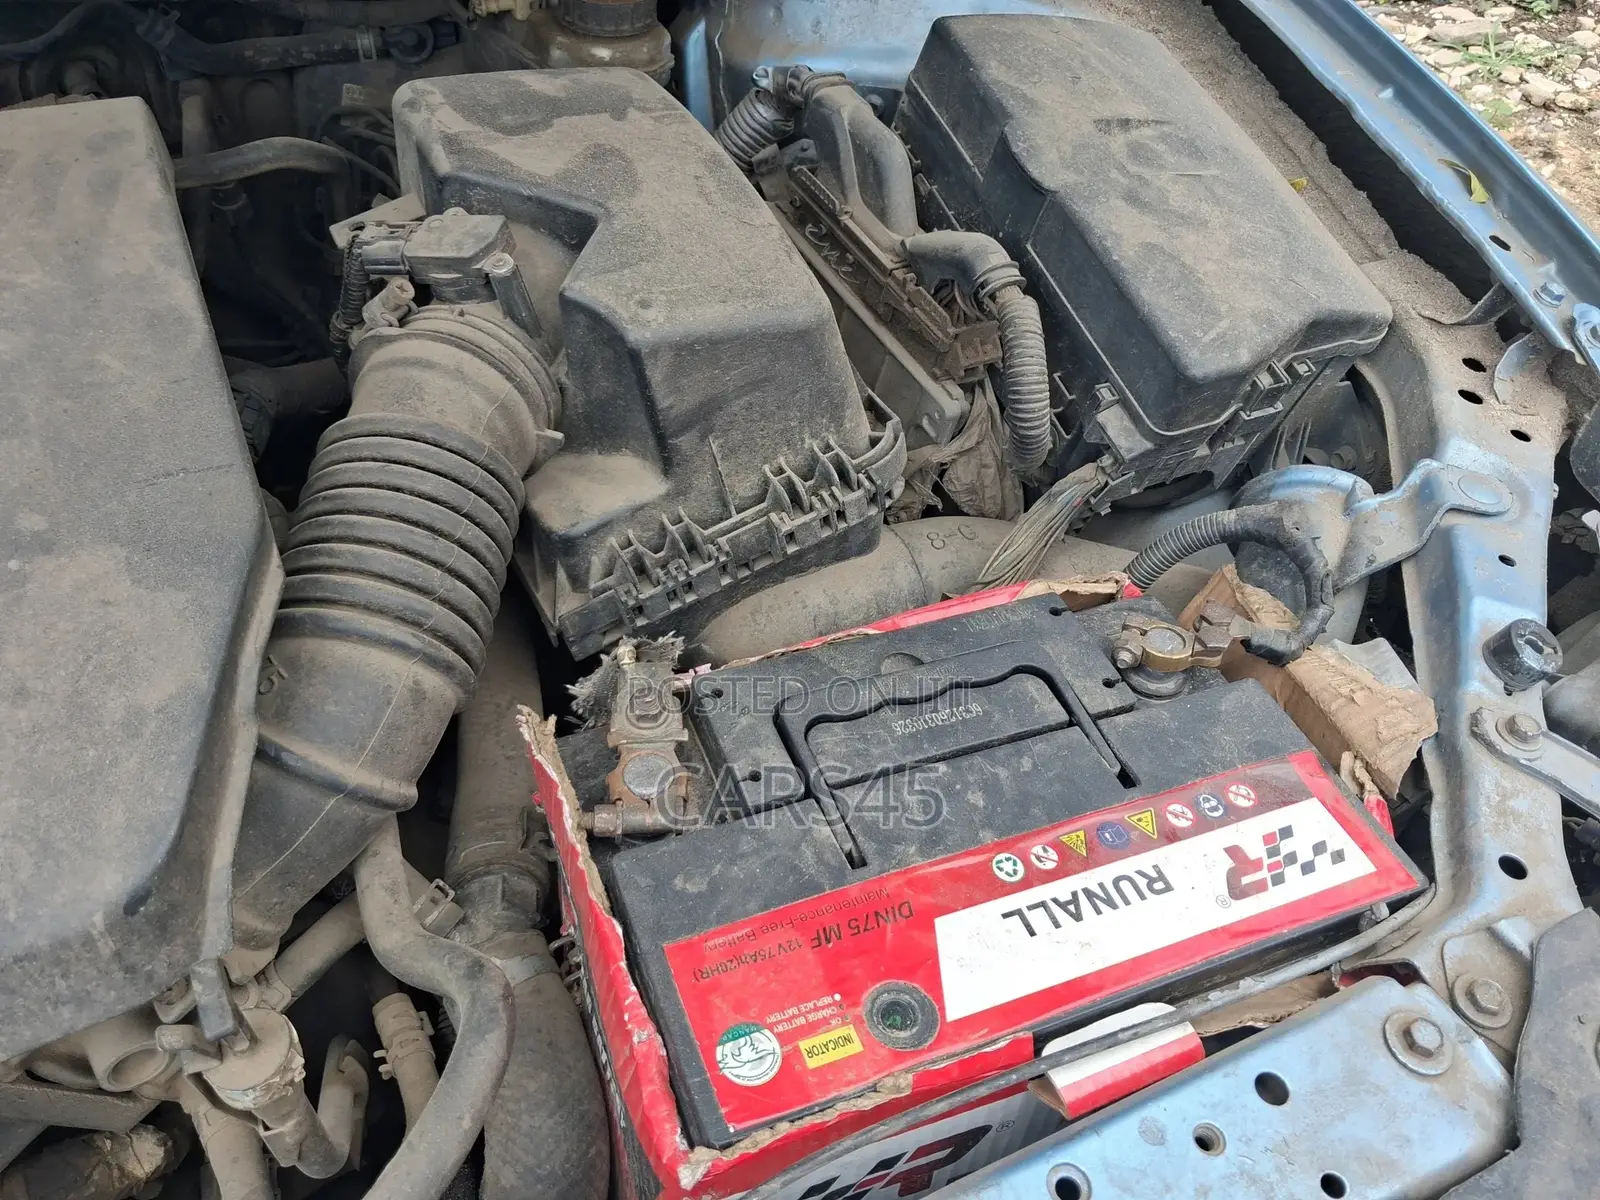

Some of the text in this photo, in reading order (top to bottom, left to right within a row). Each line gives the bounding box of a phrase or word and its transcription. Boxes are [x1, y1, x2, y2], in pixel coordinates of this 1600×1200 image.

[1001, 864, 1174, 937] RUNALL
[704, 887, 890, 953] Maintenance-Free Battery
[847, 900, 914, 938] DIN75
[777, 937, 803, 952] 12V
[809, 923, 843, 950] MF
[765, 995, 833, 1024] REPLACE BATTERY
[807, 1006, 838, 1023] CHARGE
[829, 1016, 842, 1026] OK
[772, 1014, 807, 1033] BATTERY
[804, 1032, 855, 1060] INDICATOR
